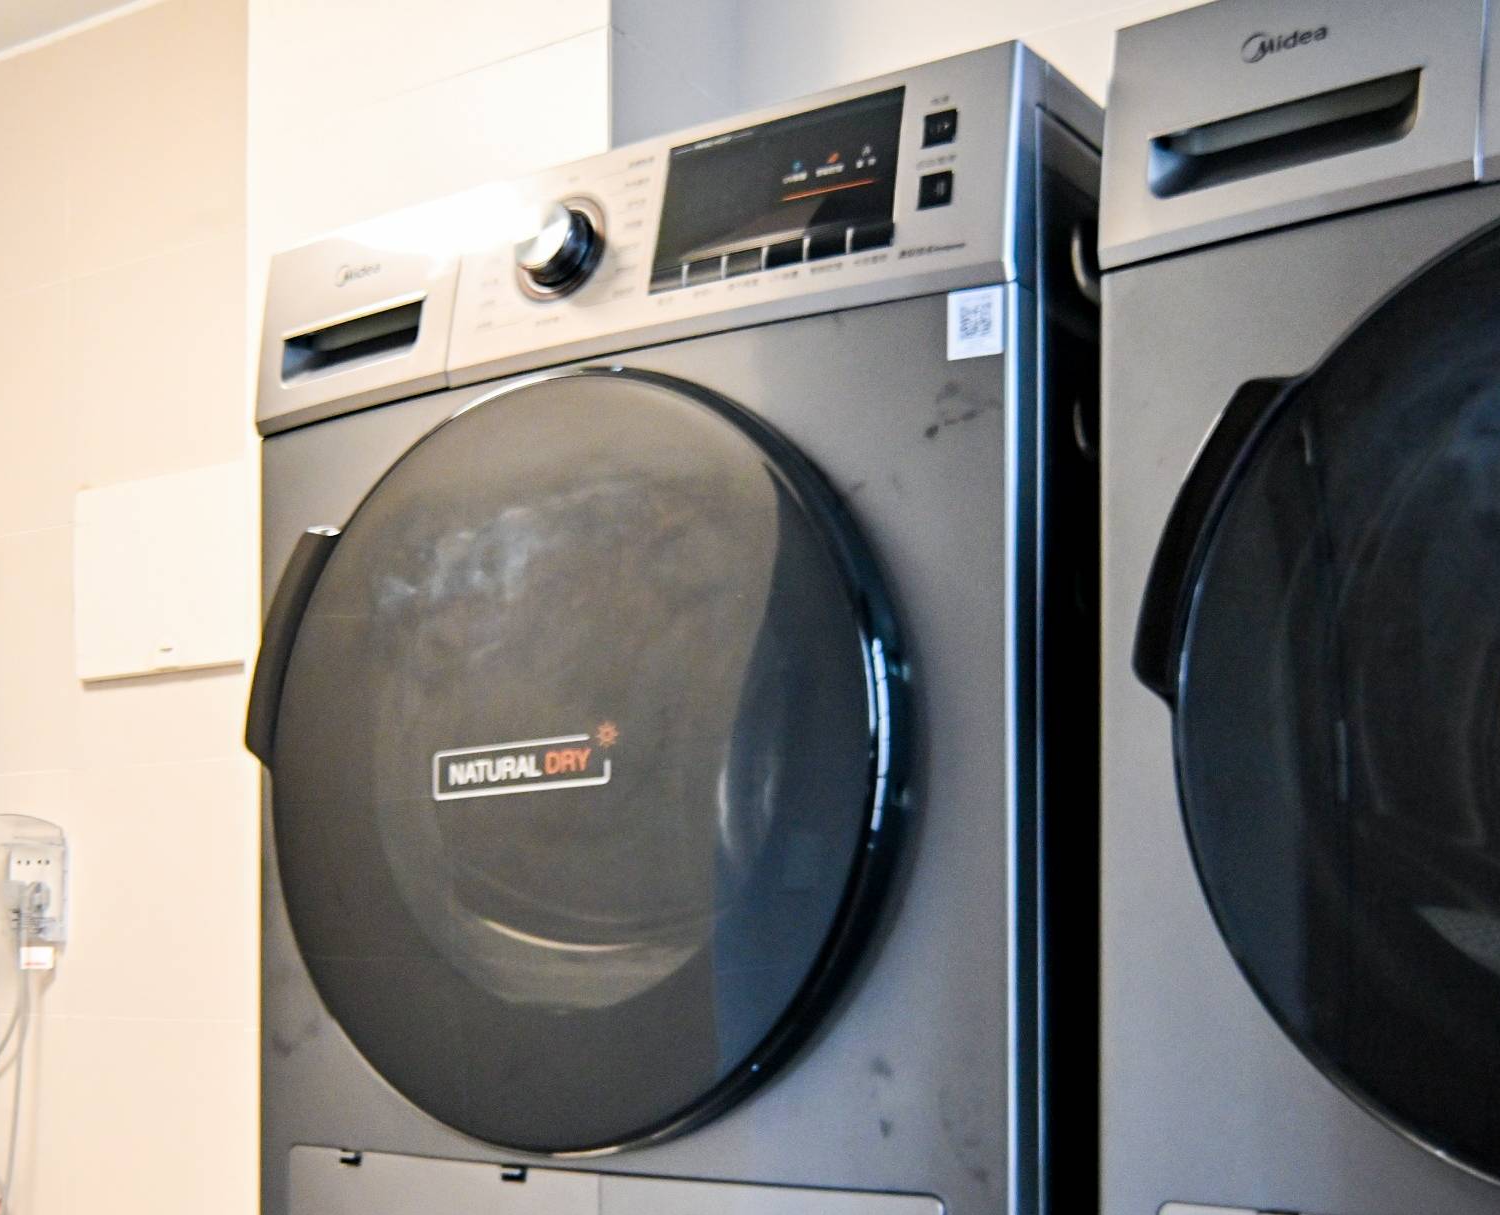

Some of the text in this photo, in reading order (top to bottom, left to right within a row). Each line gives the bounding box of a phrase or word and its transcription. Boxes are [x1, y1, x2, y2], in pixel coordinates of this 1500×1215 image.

[1241, 25, 1328, 63] Midea
[449, 748, 591, 786] NATURAL DRY
